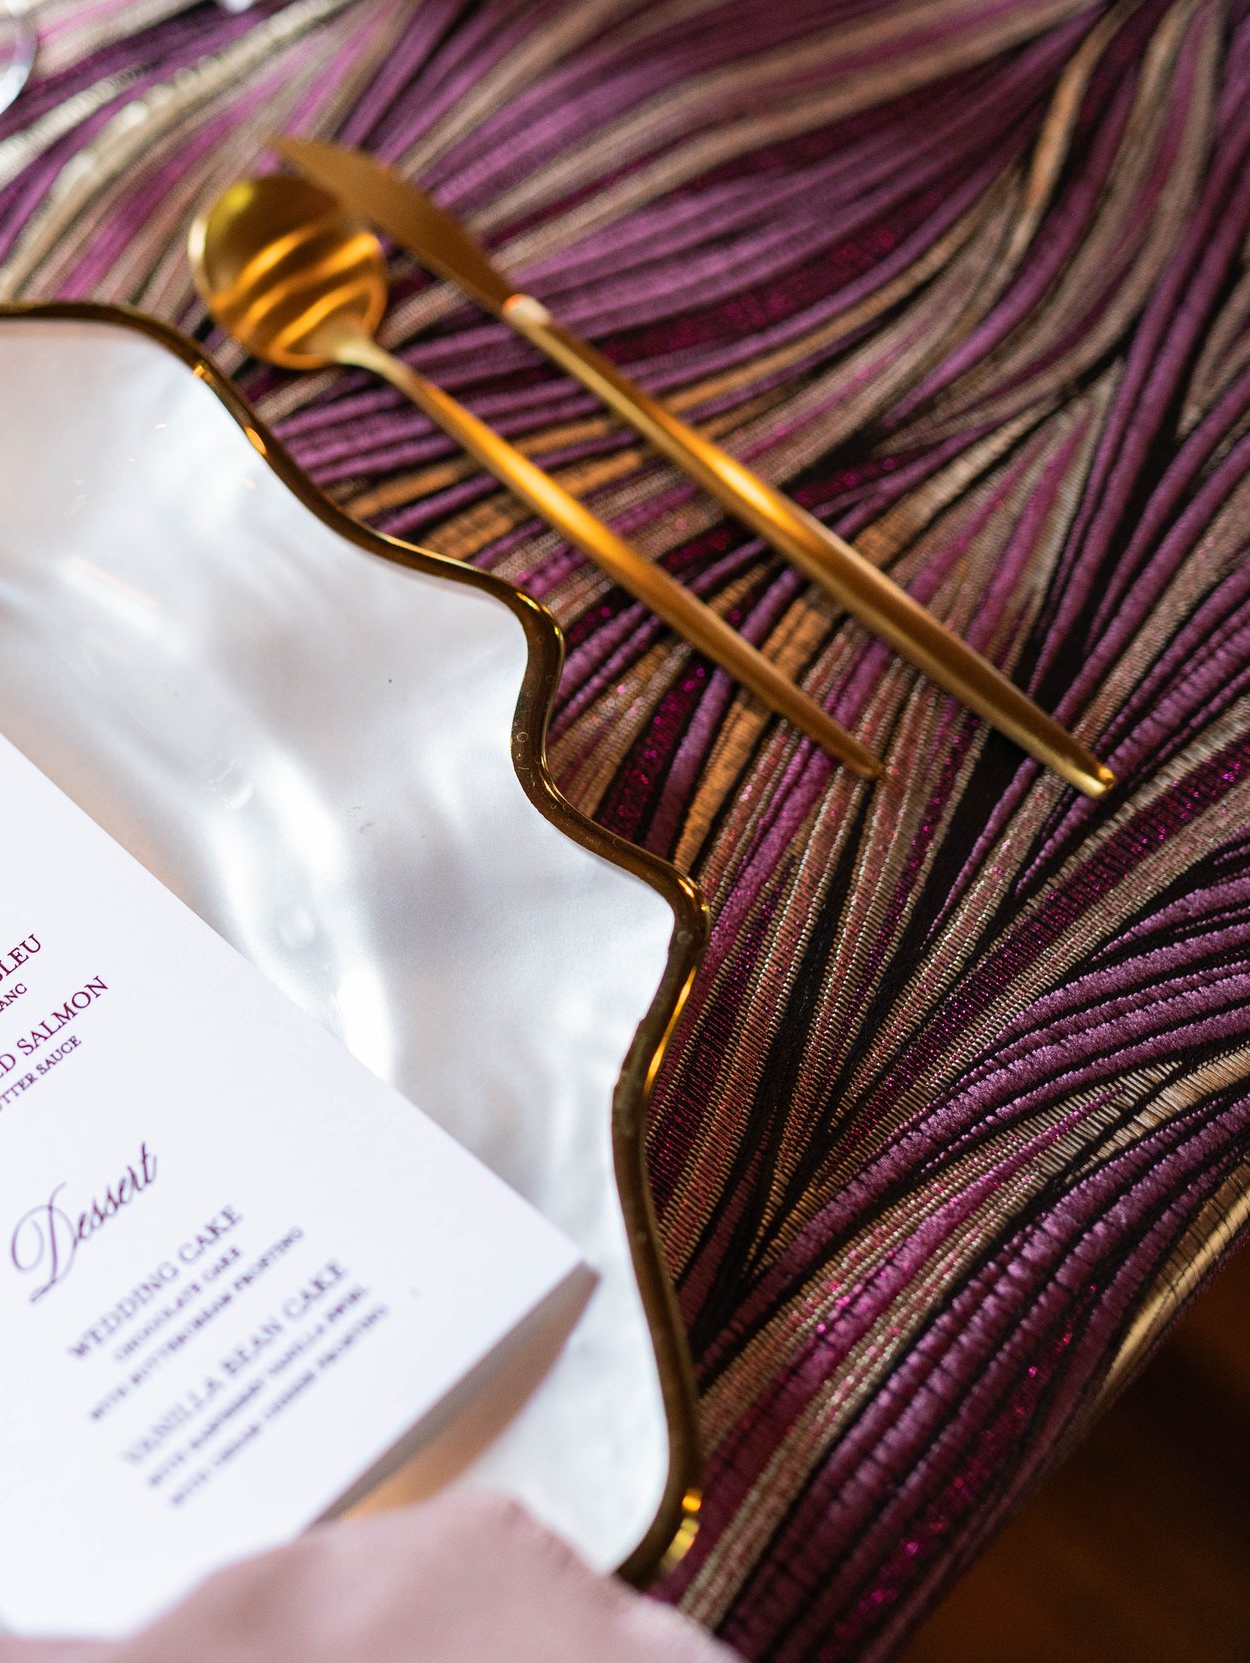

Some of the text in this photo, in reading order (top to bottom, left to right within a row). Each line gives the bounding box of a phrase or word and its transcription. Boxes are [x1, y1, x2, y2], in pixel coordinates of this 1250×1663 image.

[16, 976, 108, 1056] SALMON
[36, 1035, 82, 1075] SAUCE
[10, 1141, 157, 1304] Dessert
[67, 1205, 243, 1359] WEDDING CAKE
[221, 1315, 283, 1377] BEAN
[282, 1259, 347, 1320] CAKE
